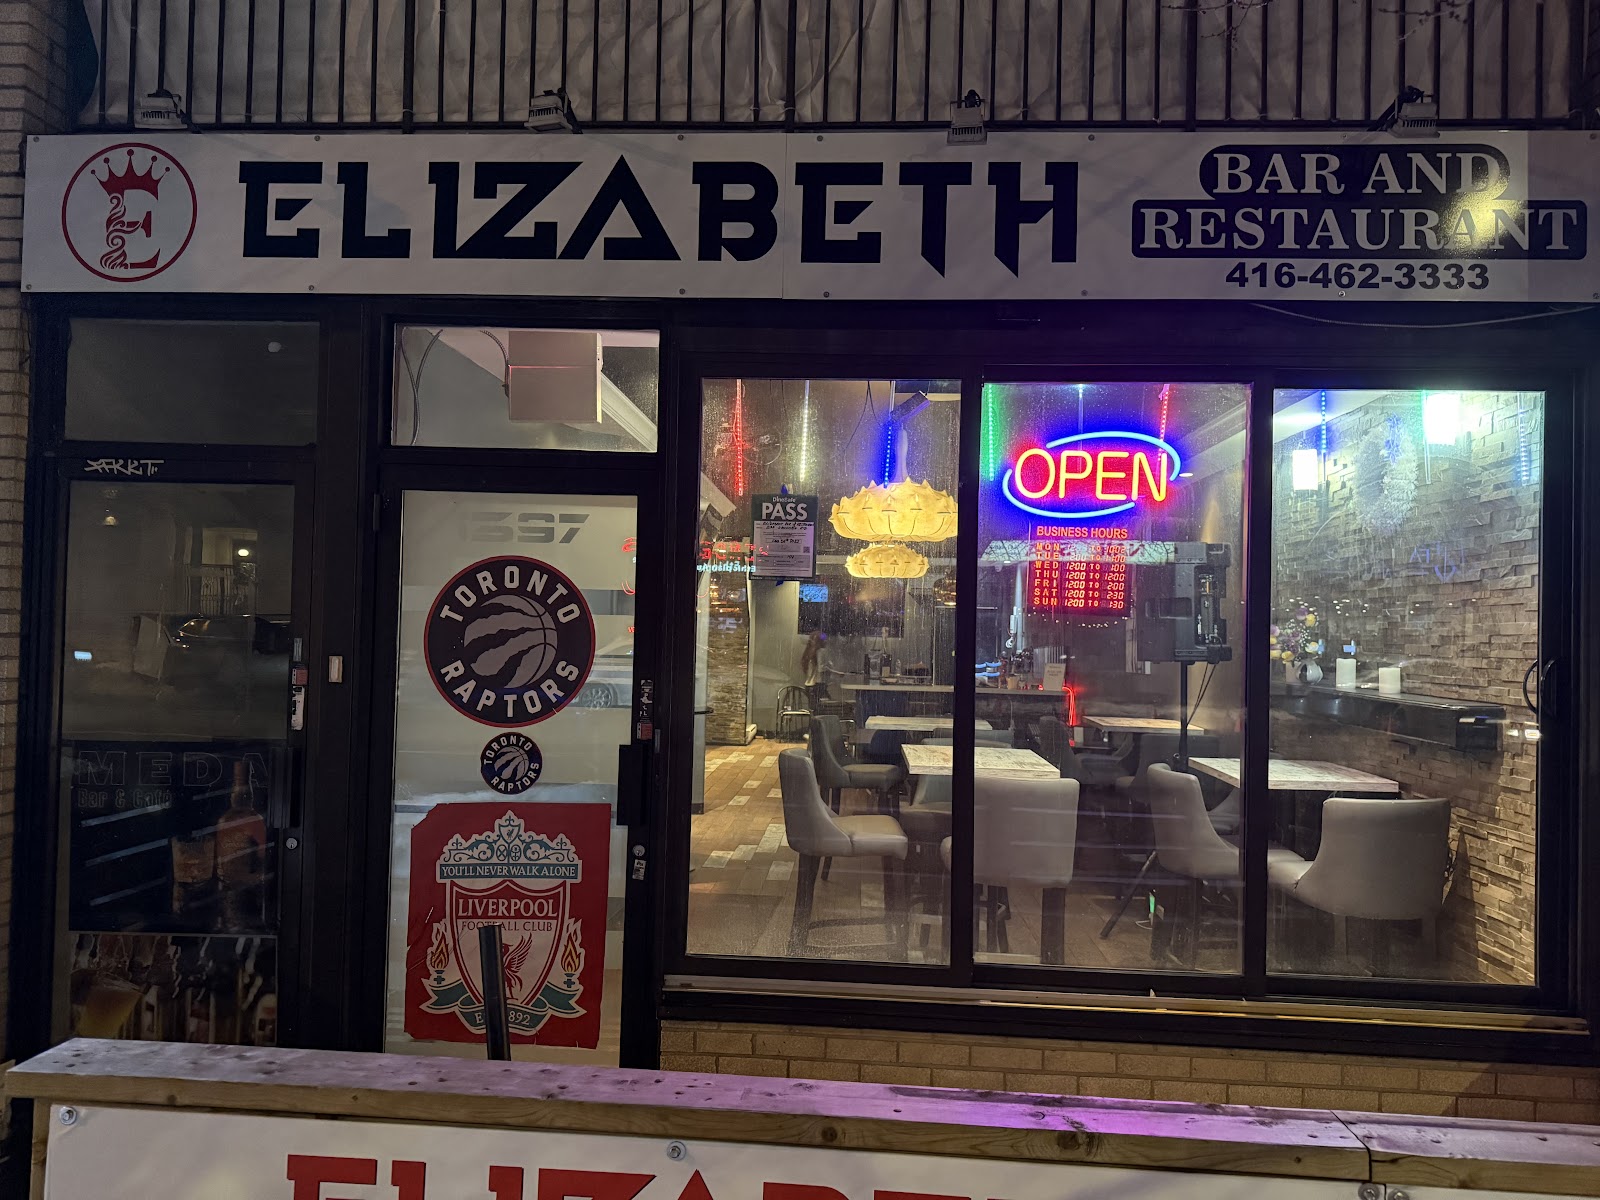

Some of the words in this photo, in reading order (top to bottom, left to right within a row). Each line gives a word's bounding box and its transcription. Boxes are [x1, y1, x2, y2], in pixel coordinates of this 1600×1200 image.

[1213, 153, 1345, 193] BAR
[1362, 152, 1500, 194] AND
[239, 154, 1078, 277] ELIZABETH
[1139, 207, 1578, 251] RESTAURANT
[1226, 261, 1490, 290] 416-462-3333
[1014, 448, 1168, 502] OPEN
[761, 502, 808, 521] PASS
[1036, 525, 1088, 538] BUSINESS
[1090, 527, 1128, 539] HOURS
[1036, 543, 1060, 551] MON
[1034, 561, 1059, 569] WED
[1035, 570, 1059, 578] THU
[1034, 579, 1058, 587] FRI
[439, 565, 581, 624] TORONTO
[1033, 588, 1058, 596] SAT
[1088, 590, 1099, 598] TO
[1033, 597, 1058, 605] SUN
[440, 659, 580, 718] RAPTORS
[483, 735, 533, 765] TORONTO
[490, 762, 539, 792] RAPTORS
[78, 788, 108, 808] Bar
[442, 865, 475, 877] YOU'LL
[476, 865, 509, 877] NEVER
[509, 865, 540, 877] WALK
[541, 865, 576, 877] ALONE
[457, 898, 558, 917] LIVERPOOL
[461, 920, 519, 932] FOOTALL
[523, 921, 553, 932] CLUB
[507, 1010, 531, 1026] 892
